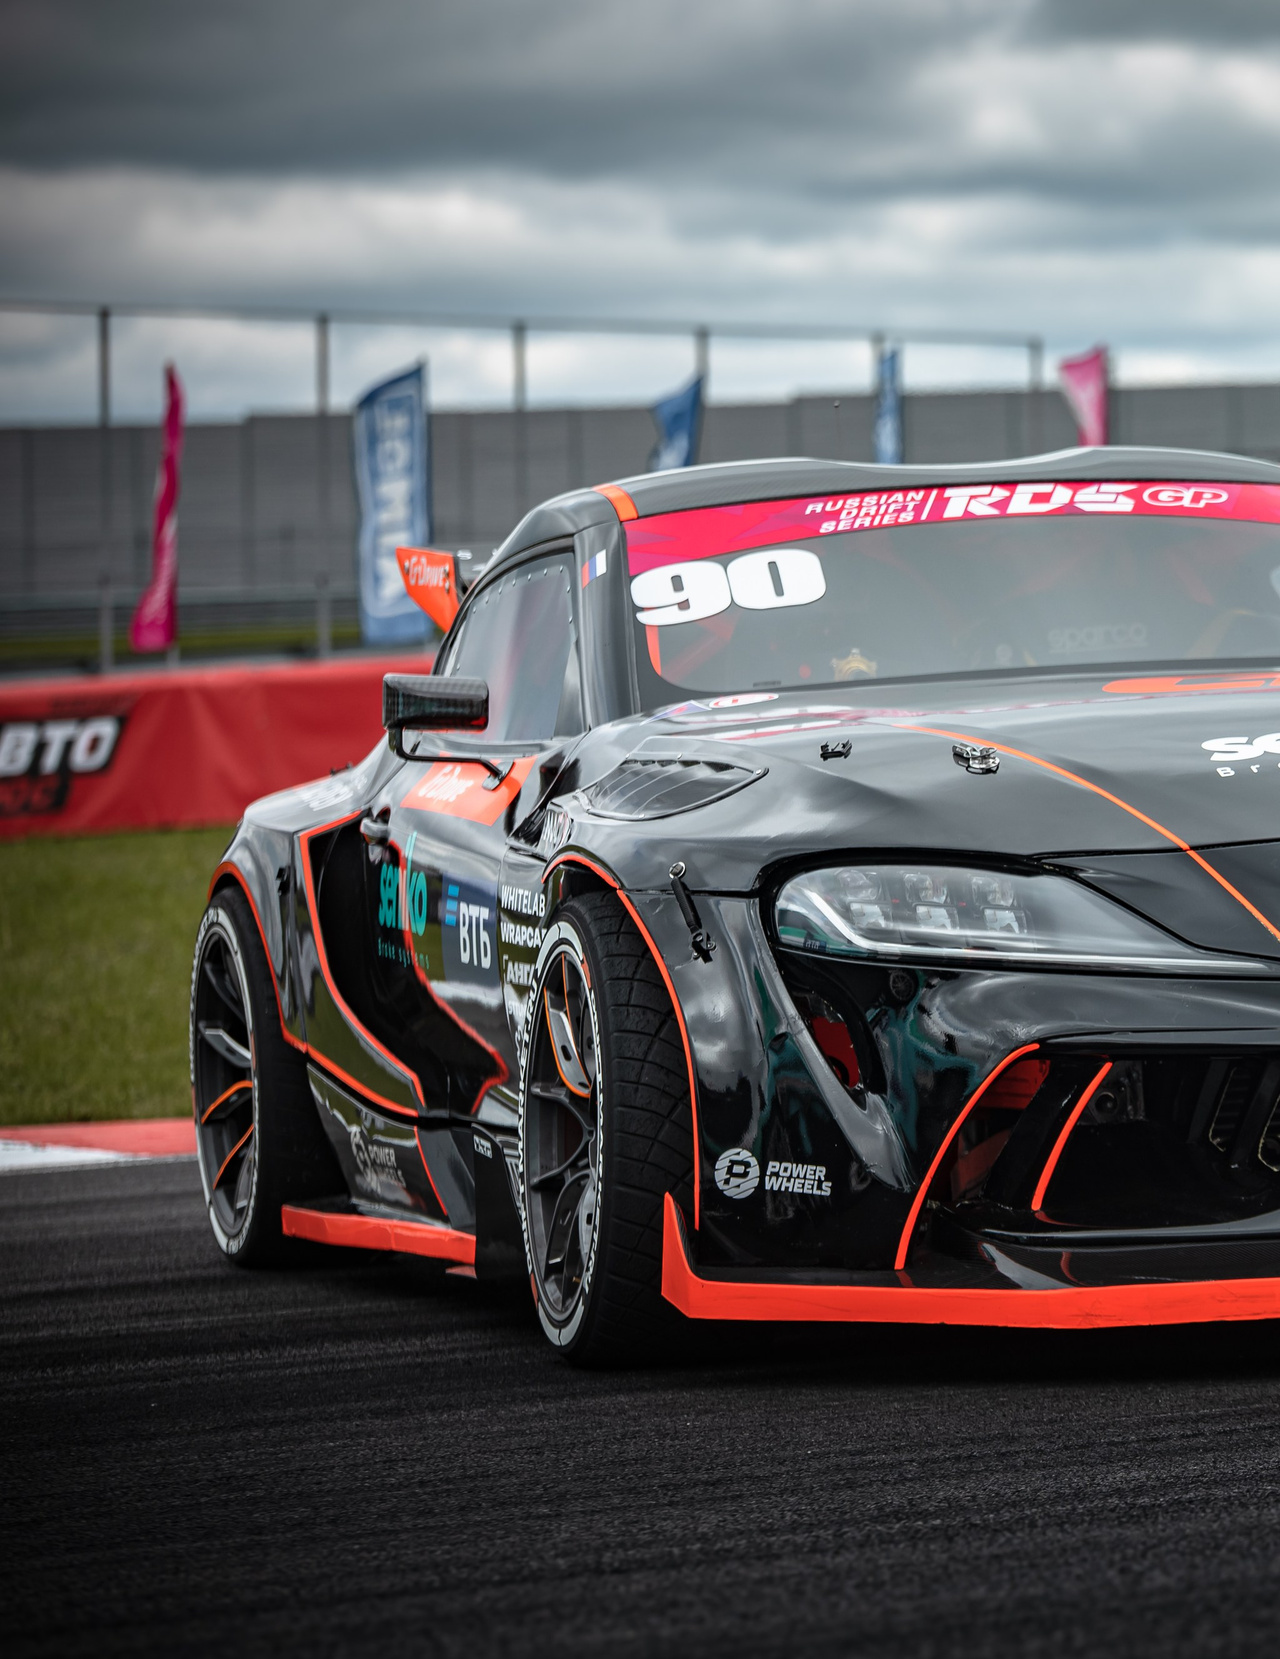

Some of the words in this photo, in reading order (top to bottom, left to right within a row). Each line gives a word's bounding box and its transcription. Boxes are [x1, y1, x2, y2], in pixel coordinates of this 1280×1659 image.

[805, 490, 925, 515] RUSSIAN
[839, 501, 920, 521] DRIFT
[942, 483, 1140, 518] RDS
[1148, 486, 1229, 508] GP
[819, 511, 916, 533] SERIES
[630, 549, 826, 626] 90
[501, 885, 546, 917] WHITELAB
[368, 1144, 397, 1168] POWER
[766, 1161, 826, 1180] POWER
[765, 1176, 832, 1196] WHEELS
